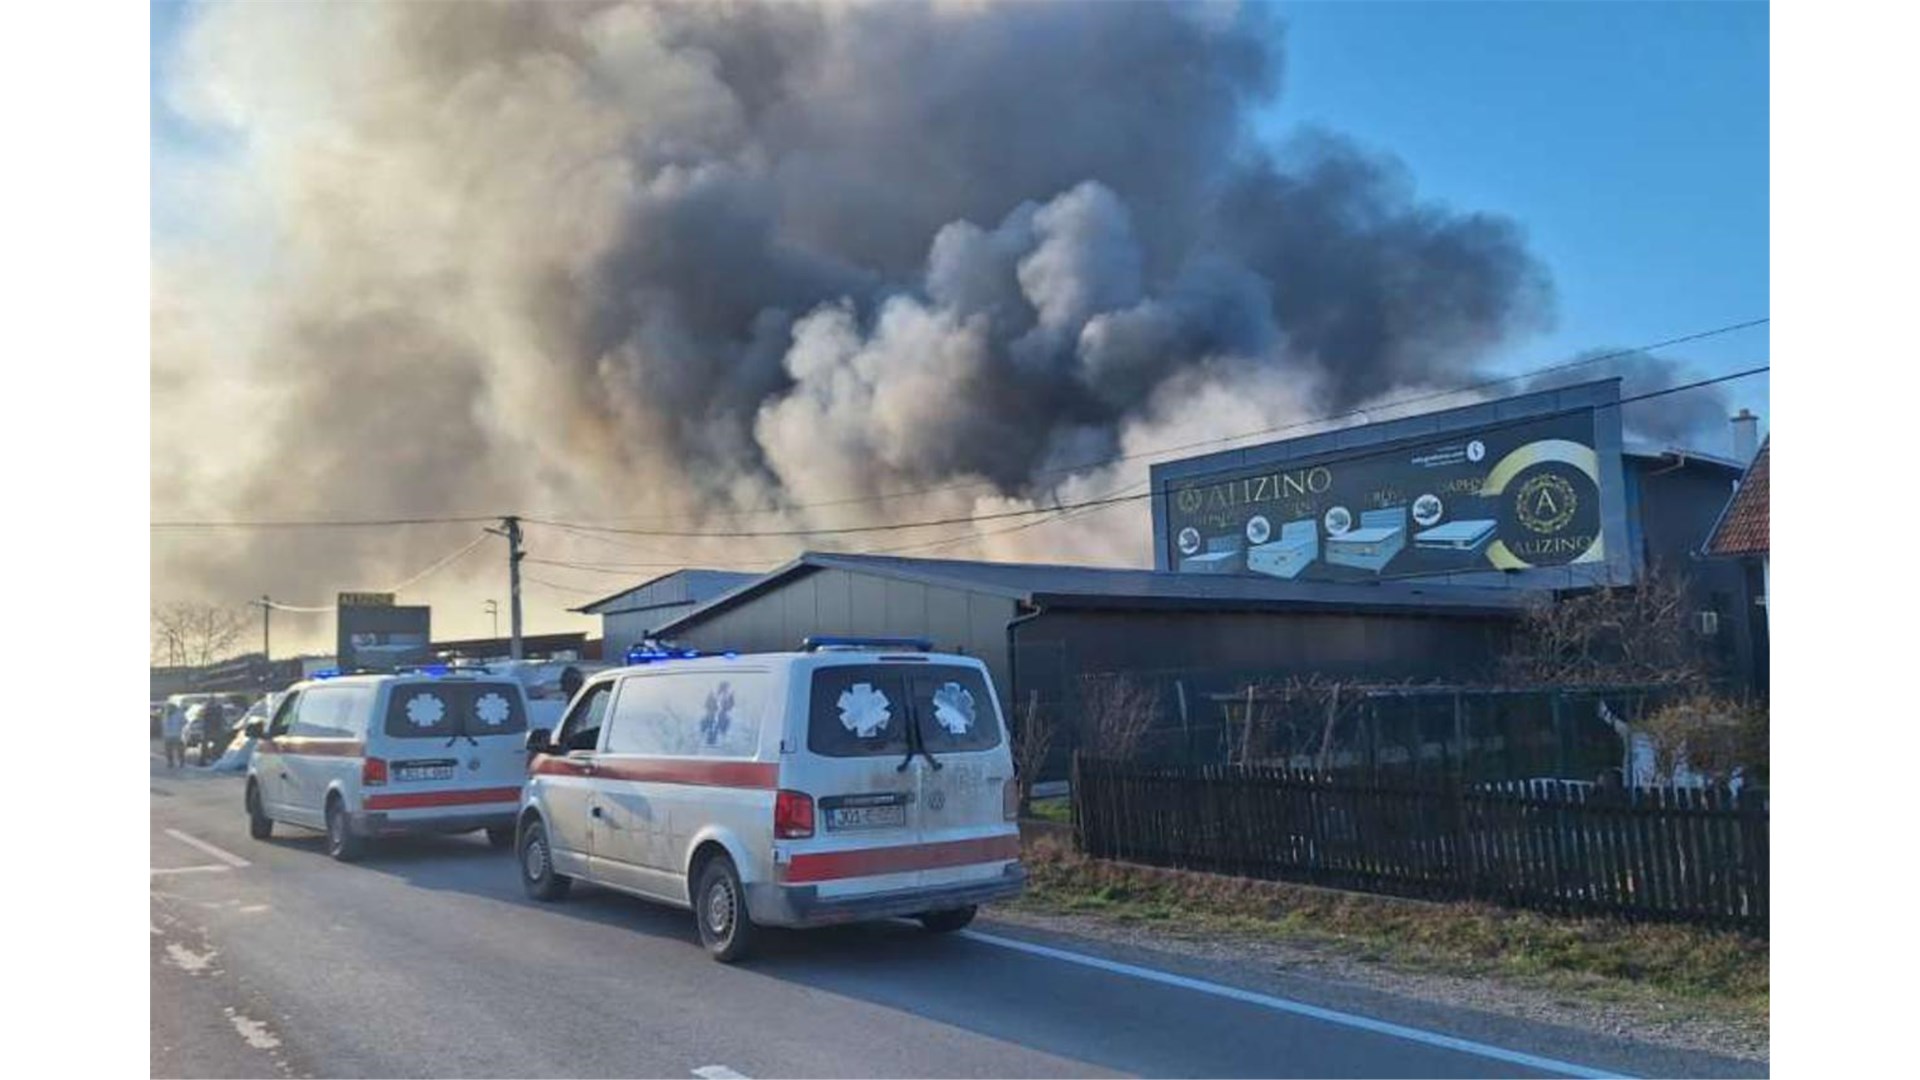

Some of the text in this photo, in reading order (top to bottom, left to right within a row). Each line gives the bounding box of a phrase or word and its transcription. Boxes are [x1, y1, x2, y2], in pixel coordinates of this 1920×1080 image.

[1207, 466, 1332, 510] ALIZINO
[1534, 487, 1557, 516] A
[1513, 535, 1593, 557] ALIZINO
